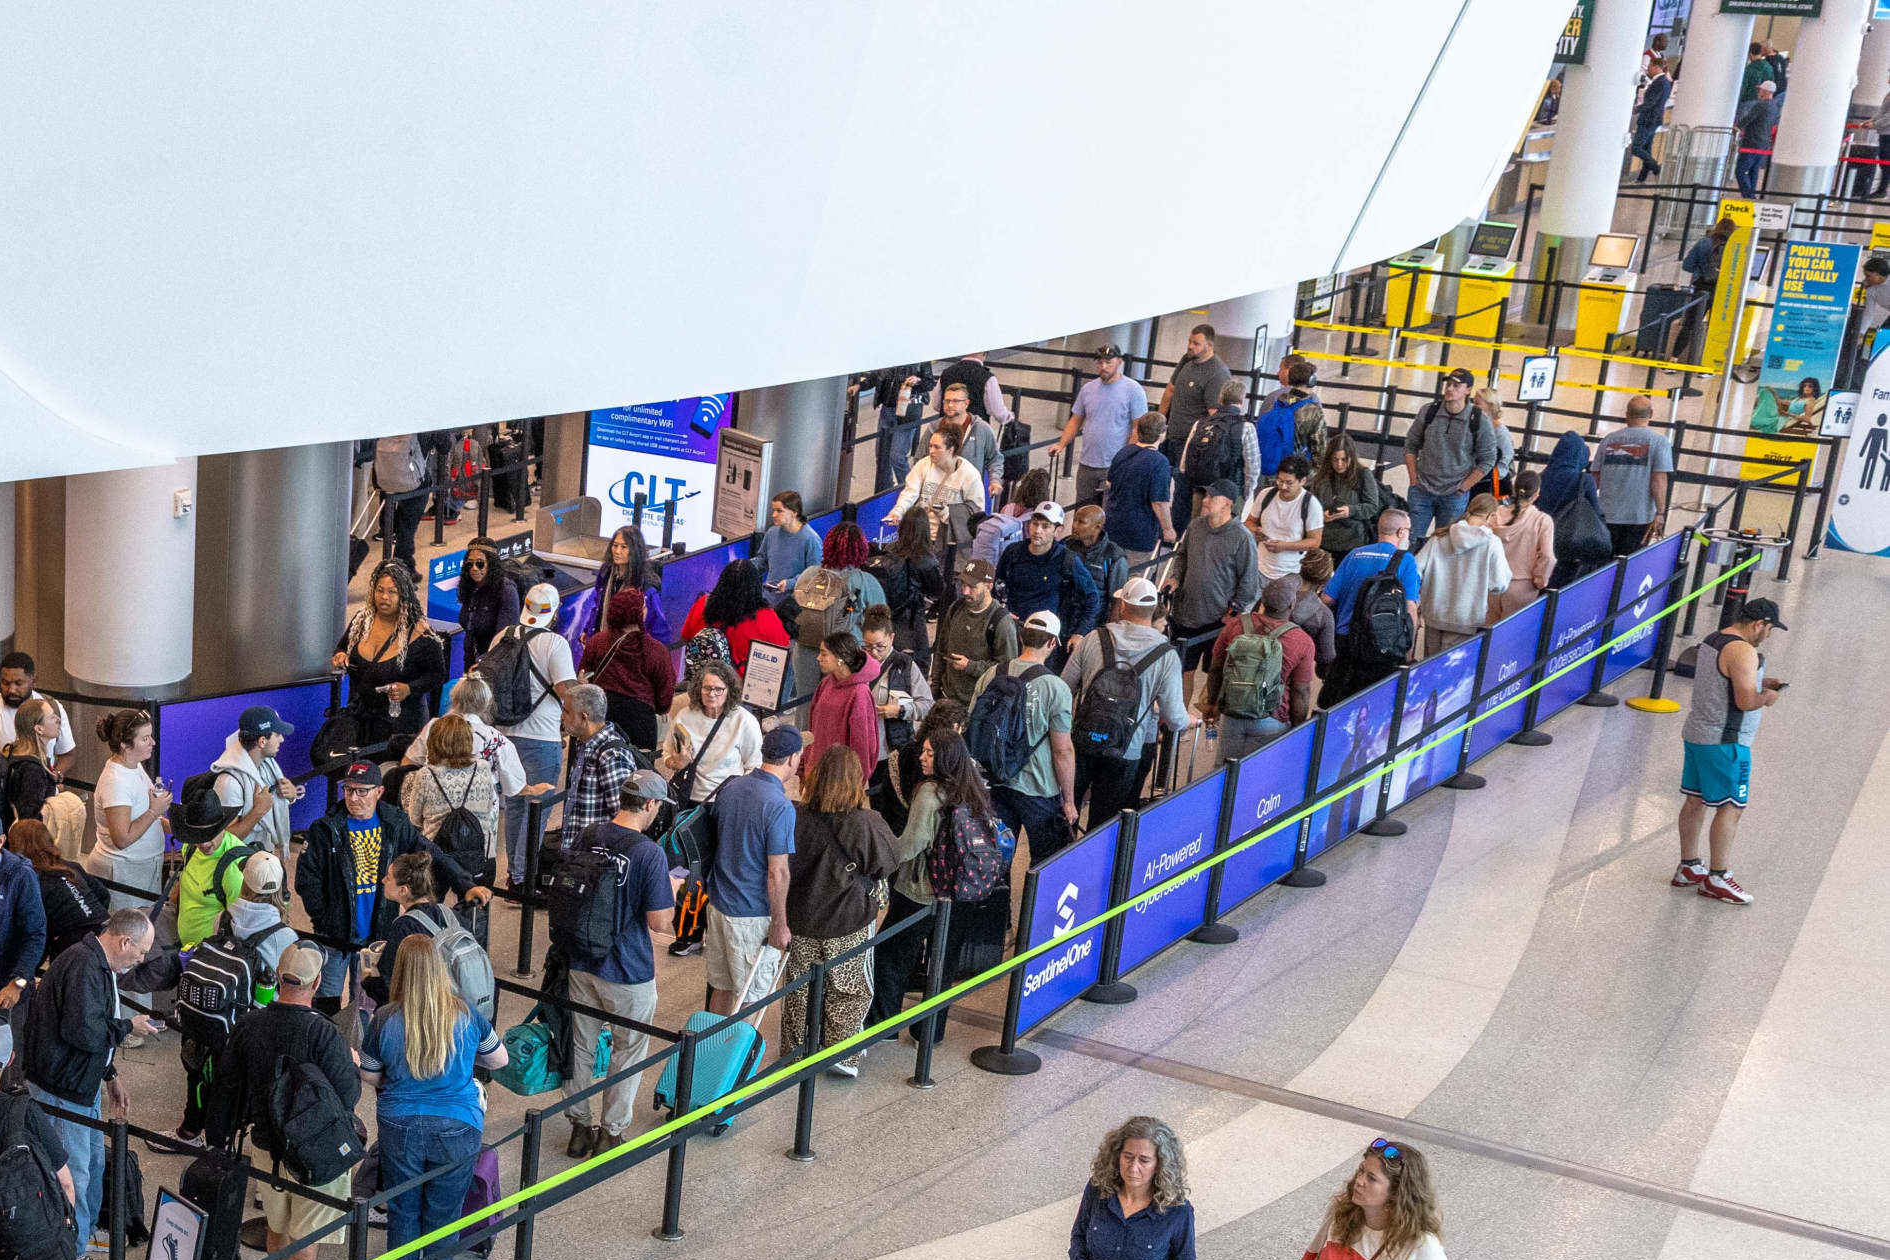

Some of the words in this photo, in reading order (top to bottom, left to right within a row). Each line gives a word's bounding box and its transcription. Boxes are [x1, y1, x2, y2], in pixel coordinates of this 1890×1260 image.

[1724, 204, 1750, 212] Check
[1790, 245, 1830, 258] POINTS
[1788, 257, 1810, 269] YOU
[1811, 258, 1834, 270] CAN
[1785, 269, 1838, 283] ACTUALLY
[1782, 280, 1805, 292] USE
[633, 405, 663, 416] unlimited
[611, 412, 658, 428] complimentary
[659, 419, 674, 429] WiFi
[623, 471, 687, 516] CLT
[1738, 784, 1747, 798] 2
[1256, 793, 1281, 819] Calm
[1143, 832, 1203, 884] AI-Powered
[1023, 939, 1092, 997] SentinelOne
